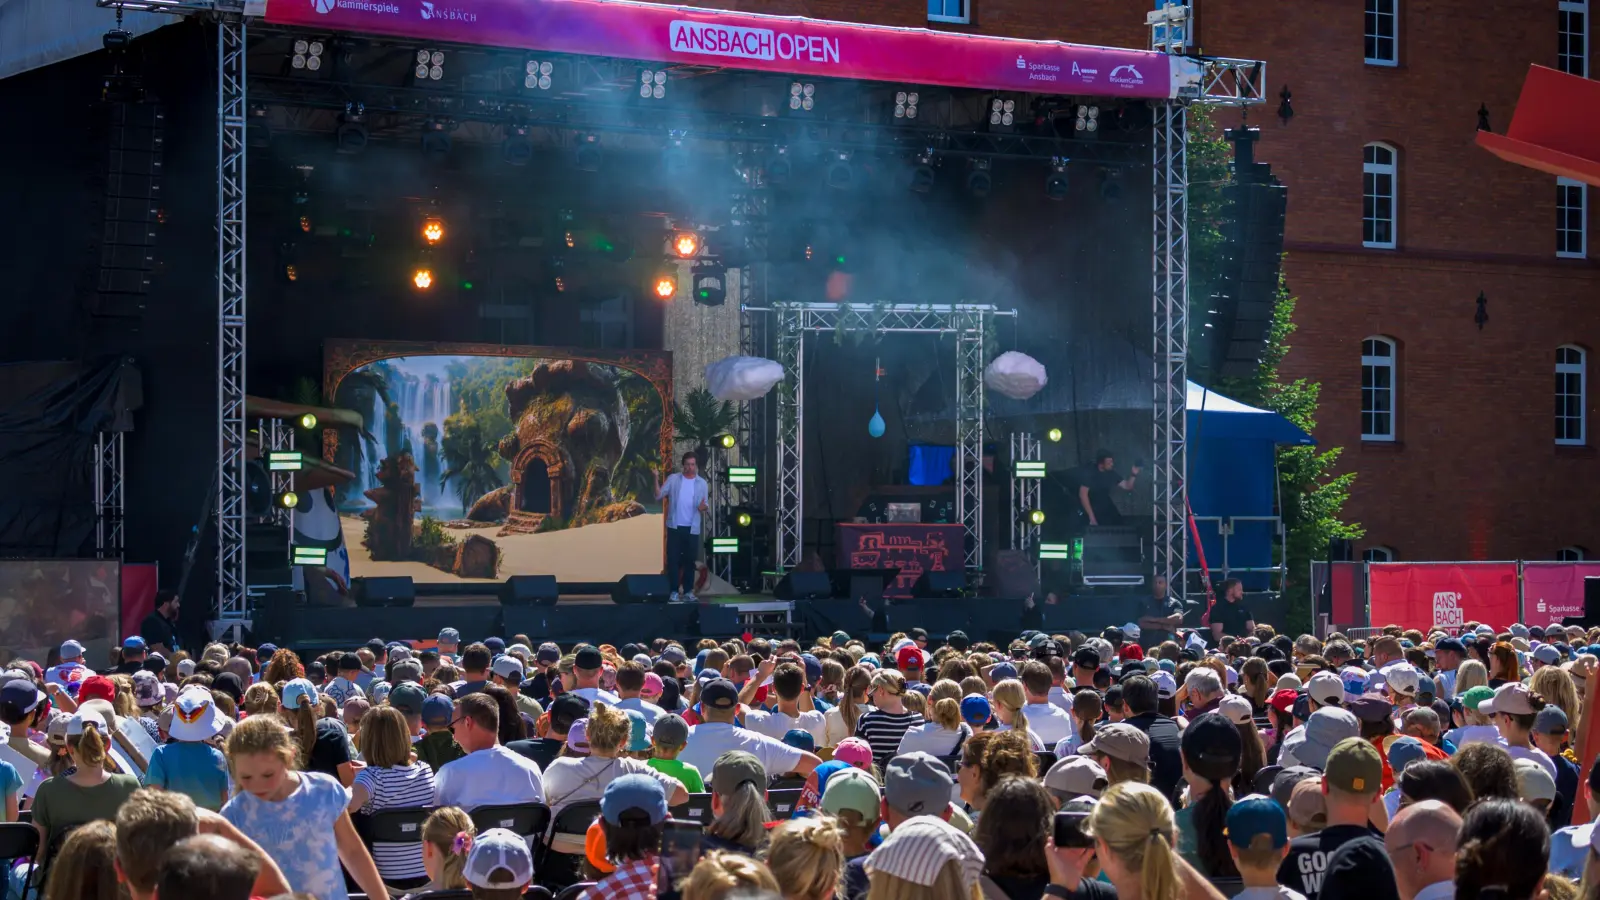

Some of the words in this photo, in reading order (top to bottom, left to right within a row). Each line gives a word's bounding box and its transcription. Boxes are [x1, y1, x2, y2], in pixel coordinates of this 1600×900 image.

[337, 0, 399, 14] kammerspiele
[427, 8, 477, 22] ANSBACH
[674, 25, 772, 56] ANSBACH
[776, 32, 840, 64] OPEN
[1028, 62, 1060, 72] Sparkasse
[1029, 72, 1057, 82] Ansbach
[1435, 593, 1455, 609] ANS
[1548, 604, 1580, 614] Sparkasse
[1435, 610, 1462, 625] BACH
